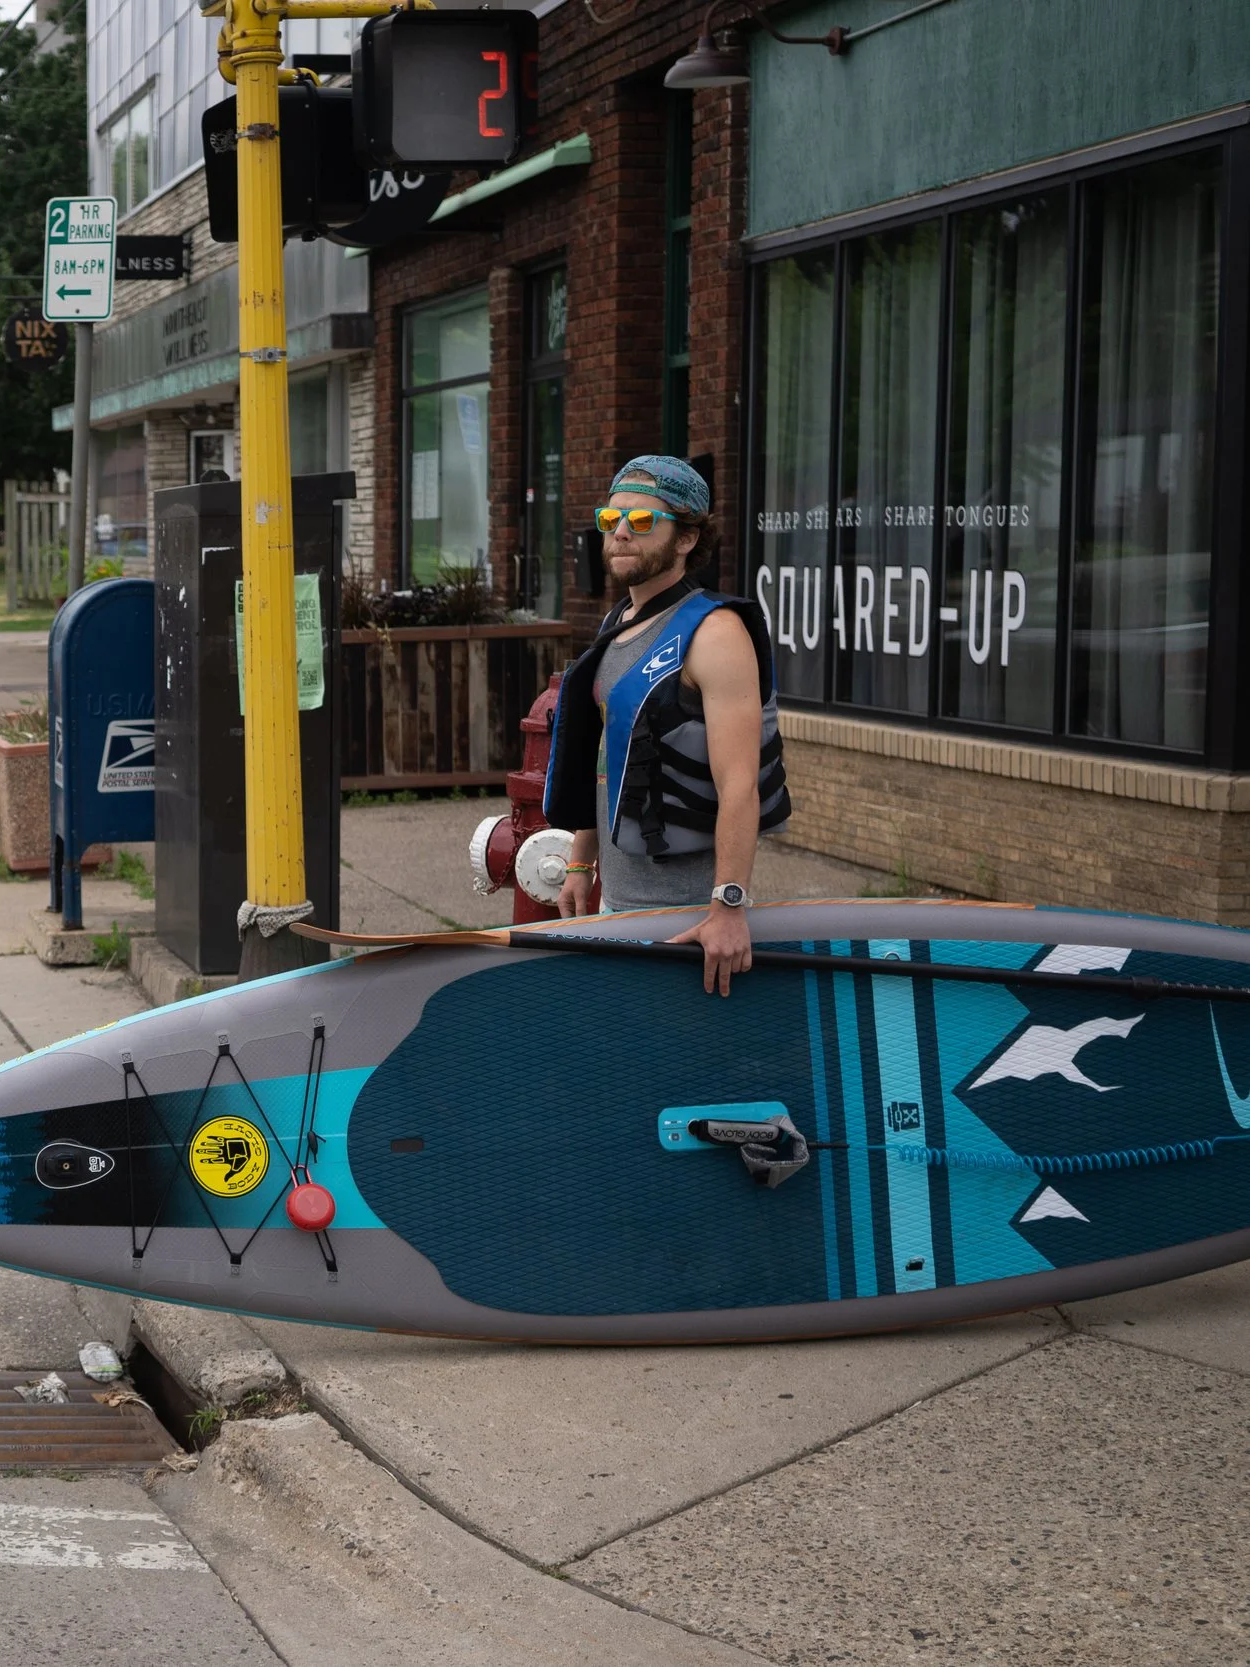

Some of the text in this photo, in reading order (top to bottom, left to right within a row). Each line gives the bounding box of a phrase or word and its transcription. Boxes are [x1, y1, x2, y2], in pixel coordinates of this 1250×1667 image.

[478, 51, 507, 137] 2
[82, 205, 100, 219] HR
[50, 207, 66, 237] 2
[70, 224, 111, 239] PARKING
[54, 260, 105, 275] 8AM-6PM
[15, 320, 58, 338] NIX
[15, 340, 46, 357] TA
[757, 511, 800, 531] SHARP
[945, 505, 1030, 528] TONGUES
[756, 564, 1026, 667] SQUARED-UP
[101, 780, 130, 788] POSTAL
[103, 771, 133, 780] UNITED
[713, 1128, 774, 1139] BODY GLOVE
[223, 1123, 262, 1190] BODY GLOVE
